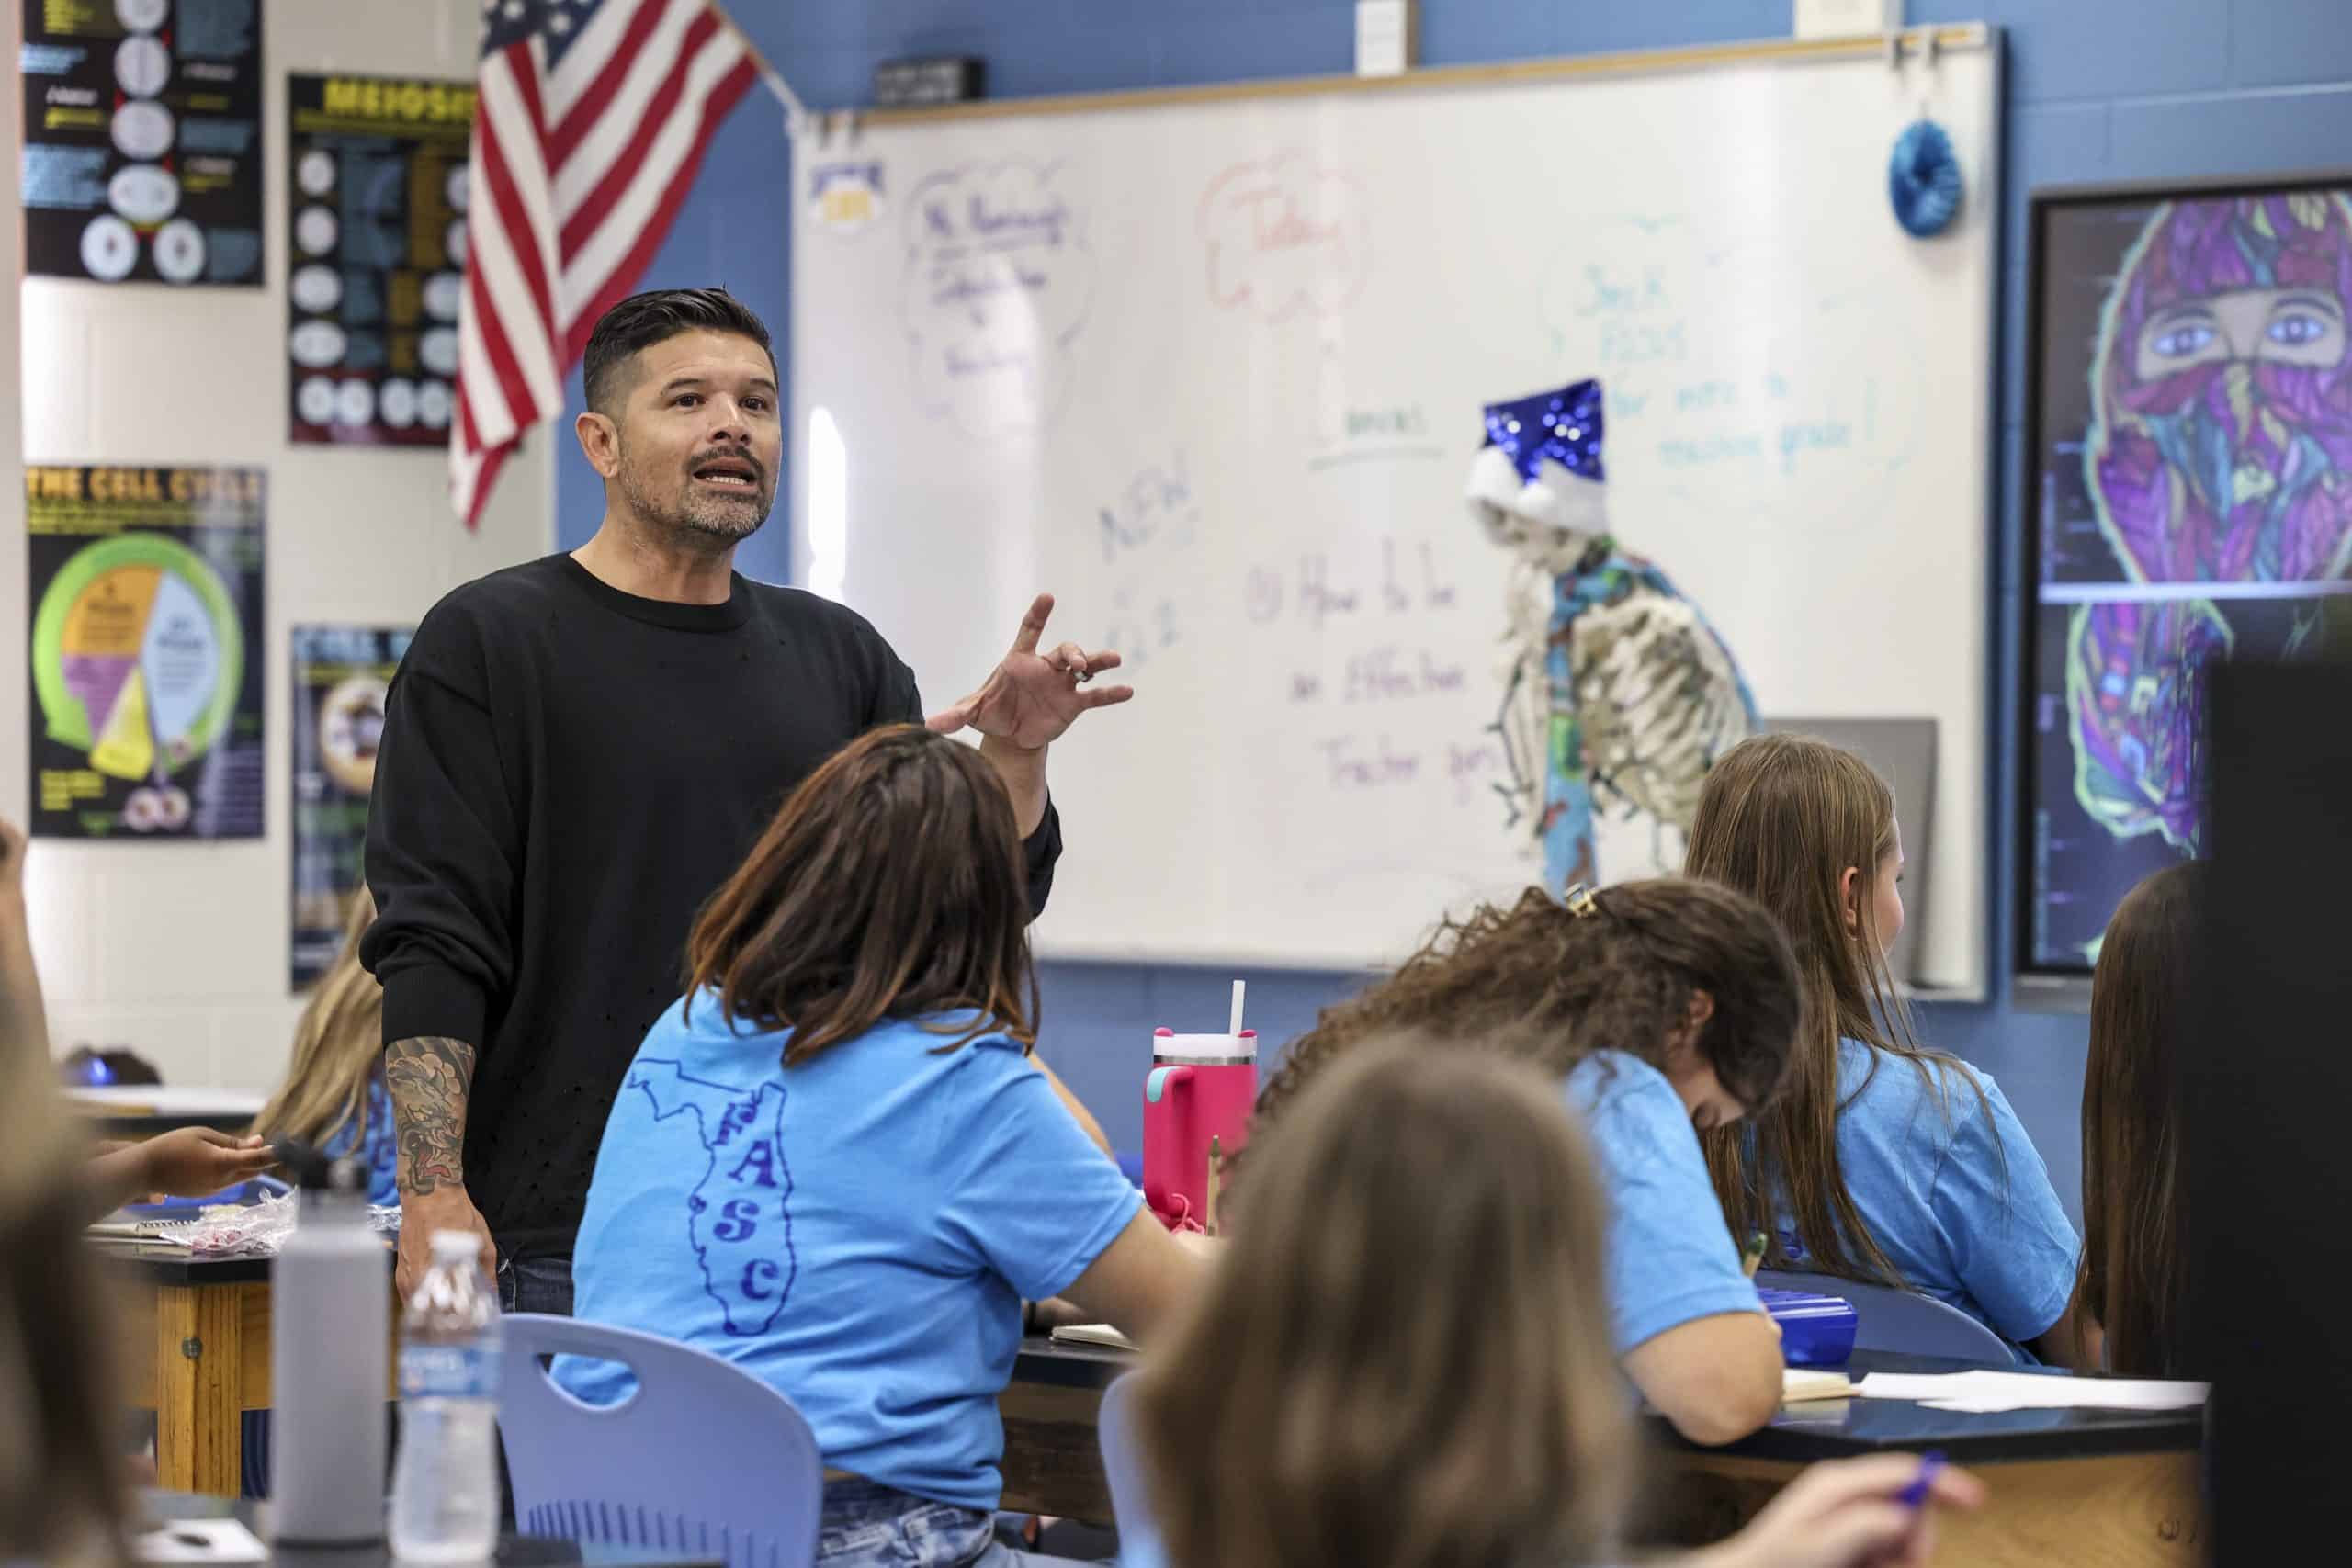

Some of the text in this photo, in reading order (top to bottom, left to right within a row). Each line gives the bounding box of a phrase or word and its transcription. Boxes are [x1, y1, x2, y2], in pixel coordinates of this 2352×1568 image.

[27, 467, 259, 502] THE CELL CYCLE
